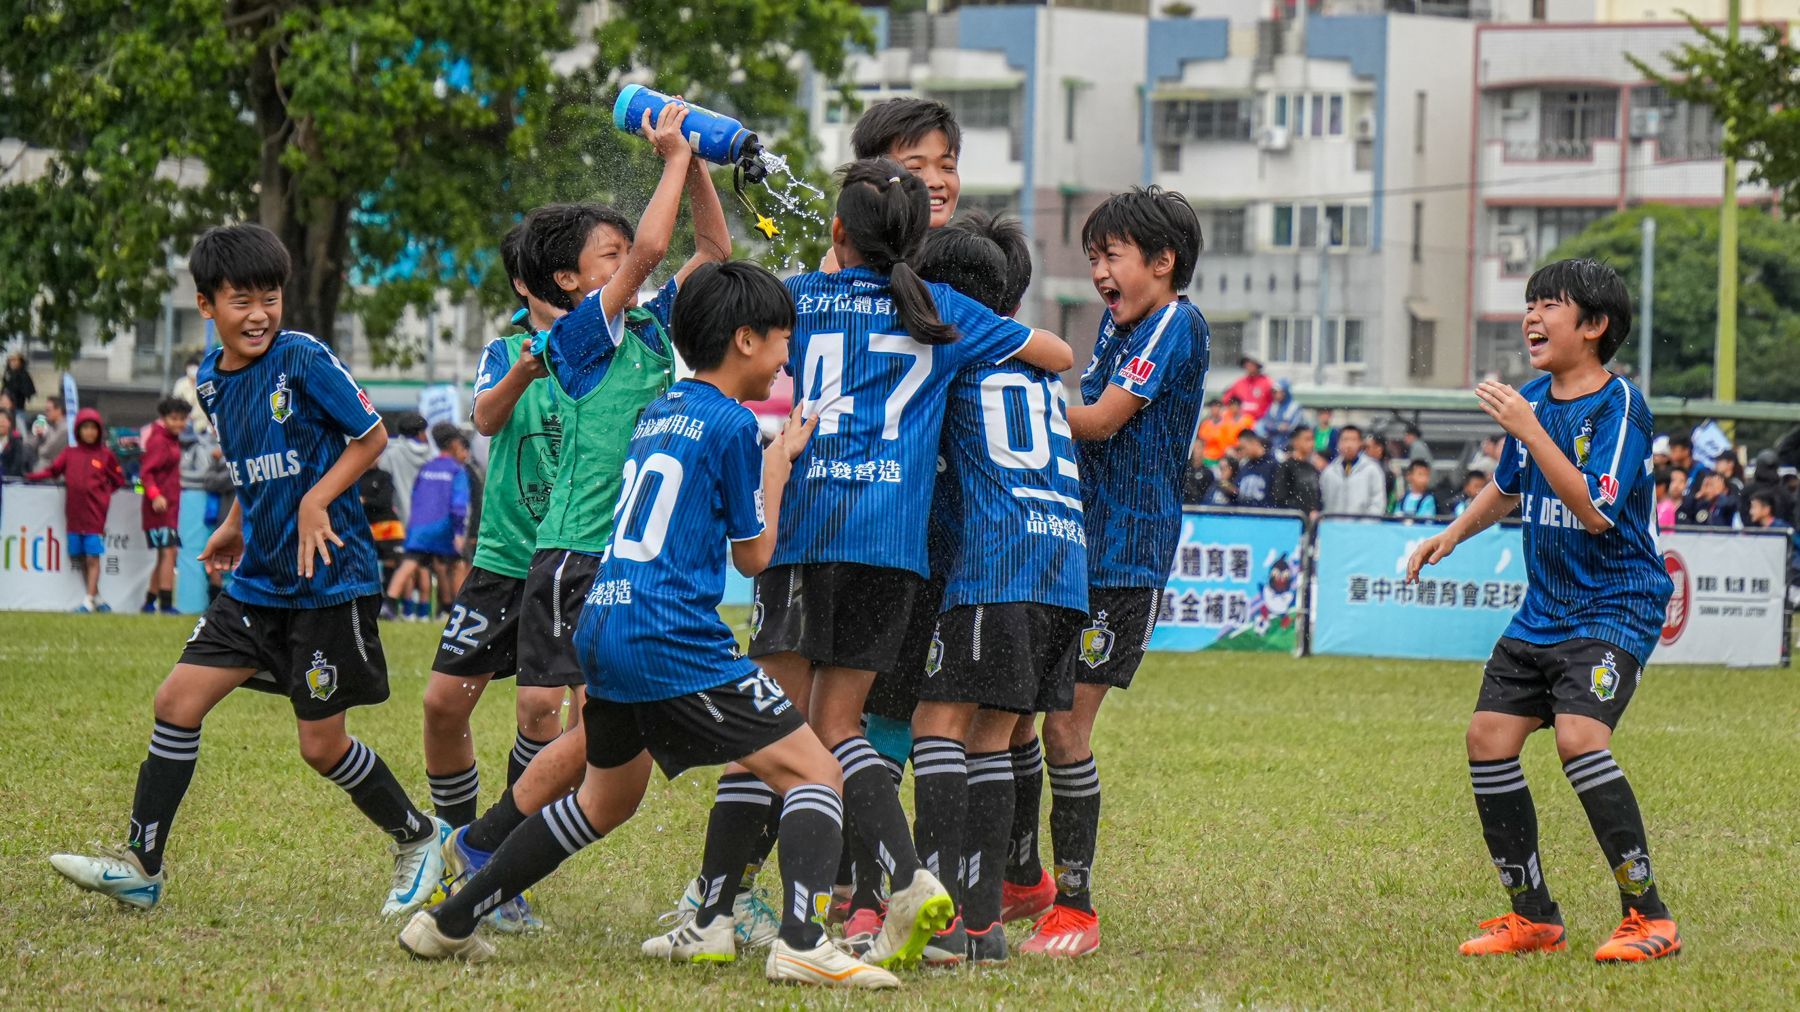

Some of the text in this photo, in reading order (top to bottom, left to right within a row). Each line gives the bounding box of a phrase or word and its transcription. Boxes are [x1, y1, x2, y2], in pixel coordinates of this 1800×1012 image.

[852, 279, 885, 290] ENTE
[796, 293, 898, 317] 全方位體育
[1124, 356, 1155, 380] All
[801, 331, 934, 441] 47
[246, 450, 301, 484] DEVILS
[806, 456, 903, 484] 品發營造
[601, 452, 684, 563] 20
[443, 604, 488, 648] 32
[441, 642, 465, 656] ENTES
